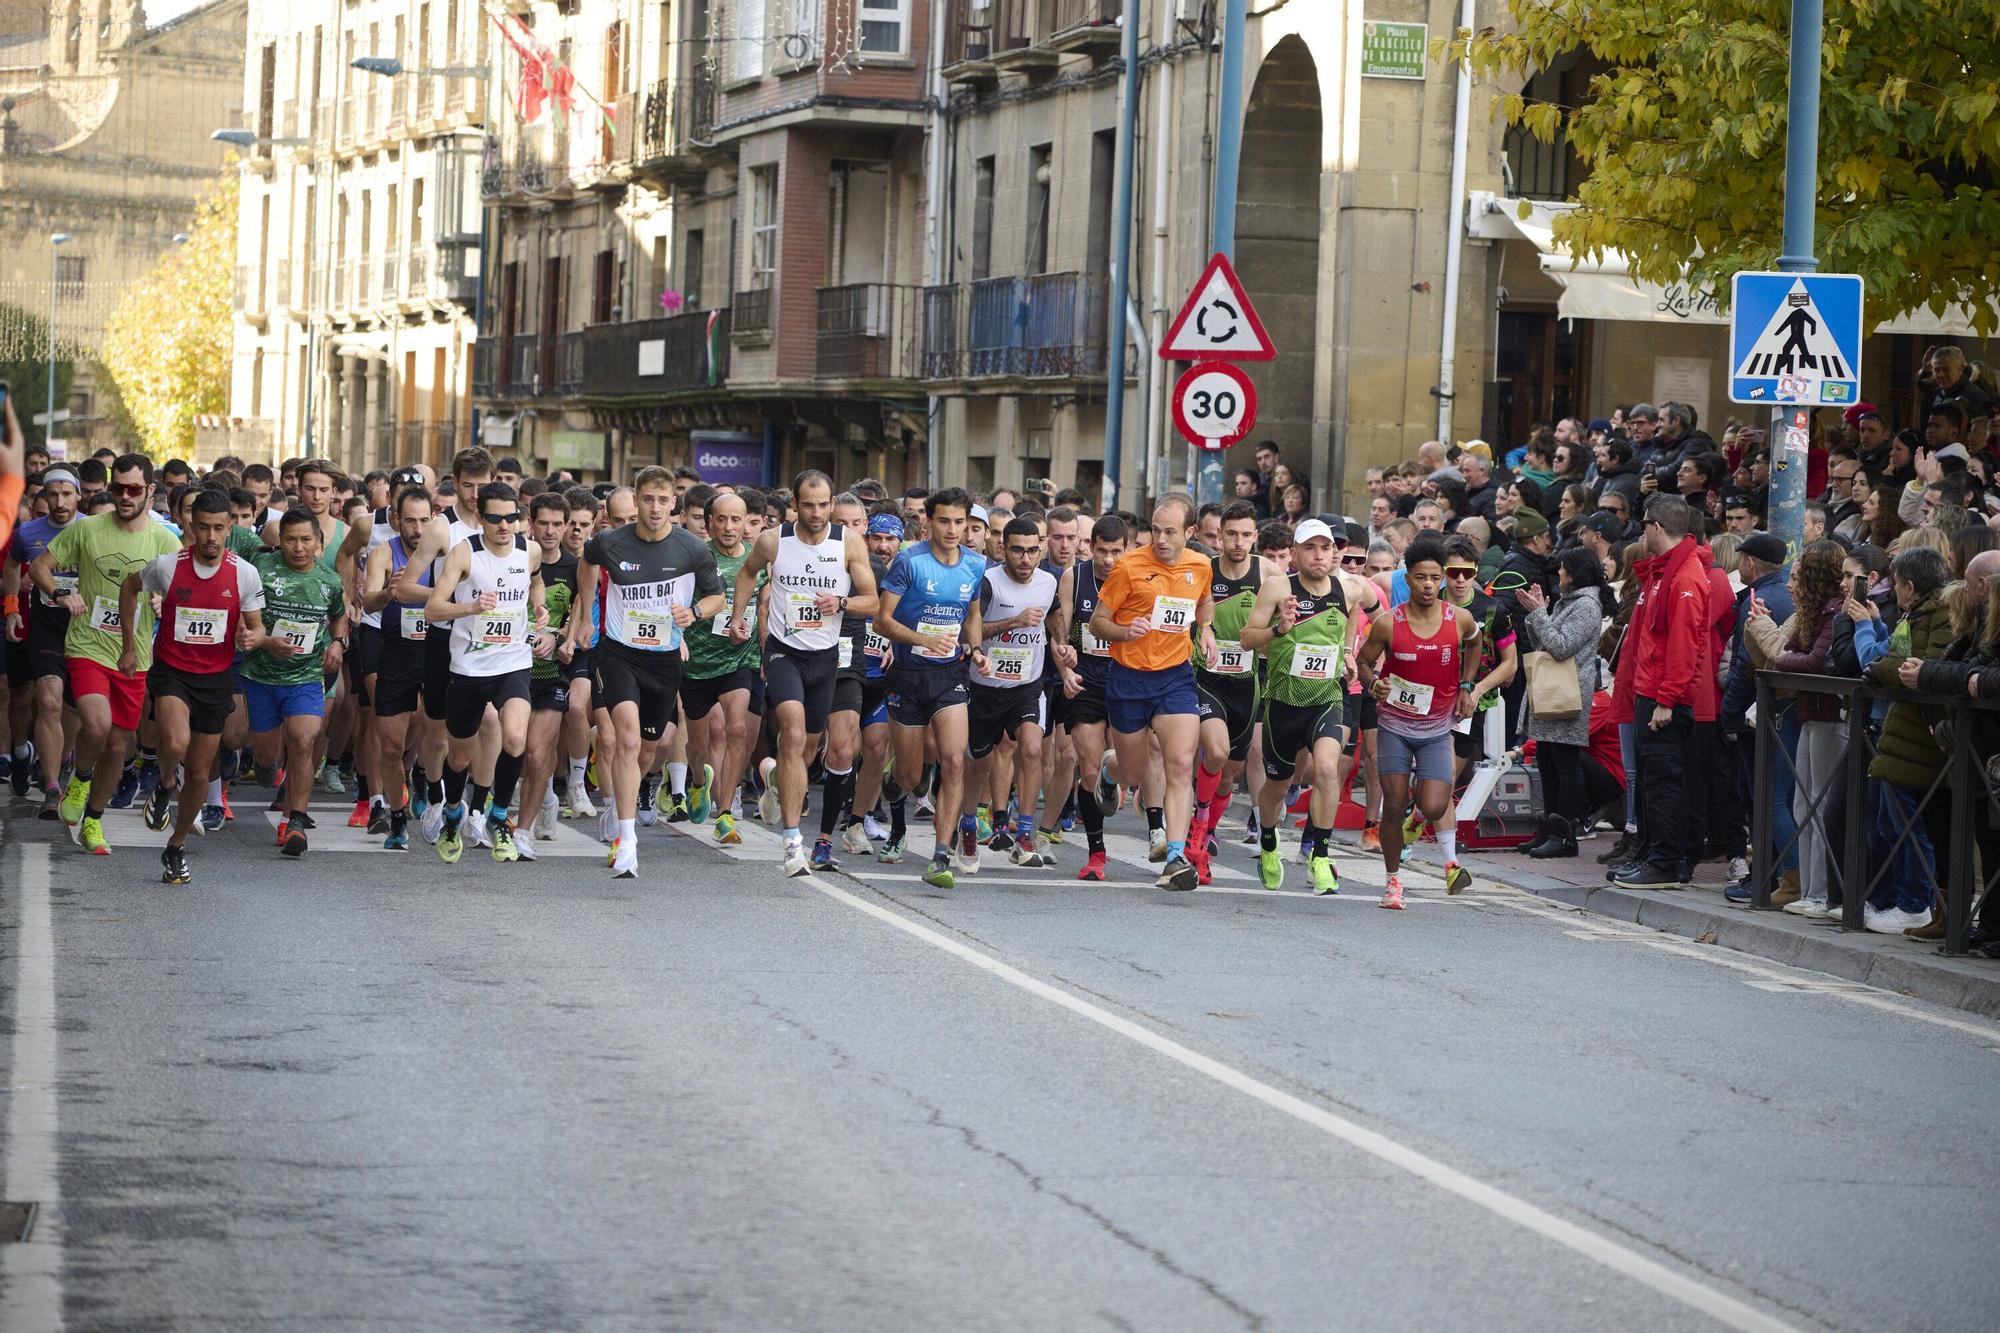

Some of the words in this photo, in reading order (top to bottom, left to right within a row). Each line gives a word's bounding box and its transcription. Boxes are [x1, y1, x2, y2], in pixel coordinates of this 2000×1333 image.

[1192, 390, 1236, 419] 30
[779, 574, 837, 589] etxenike
[798, 607, 822, 621] 133
[1164, 609, 1186, 626] 347
[188, 622, 213, 636] 412
[486, 621, 511, 636] 240
[638, 624, 657, 638] 53
[1221, 652, 1242, 666] 157
[1305, 657, 1328, 671] 321
[997, 660, 1021, 674] 255
[1399, 690, 1416, 706] 64
